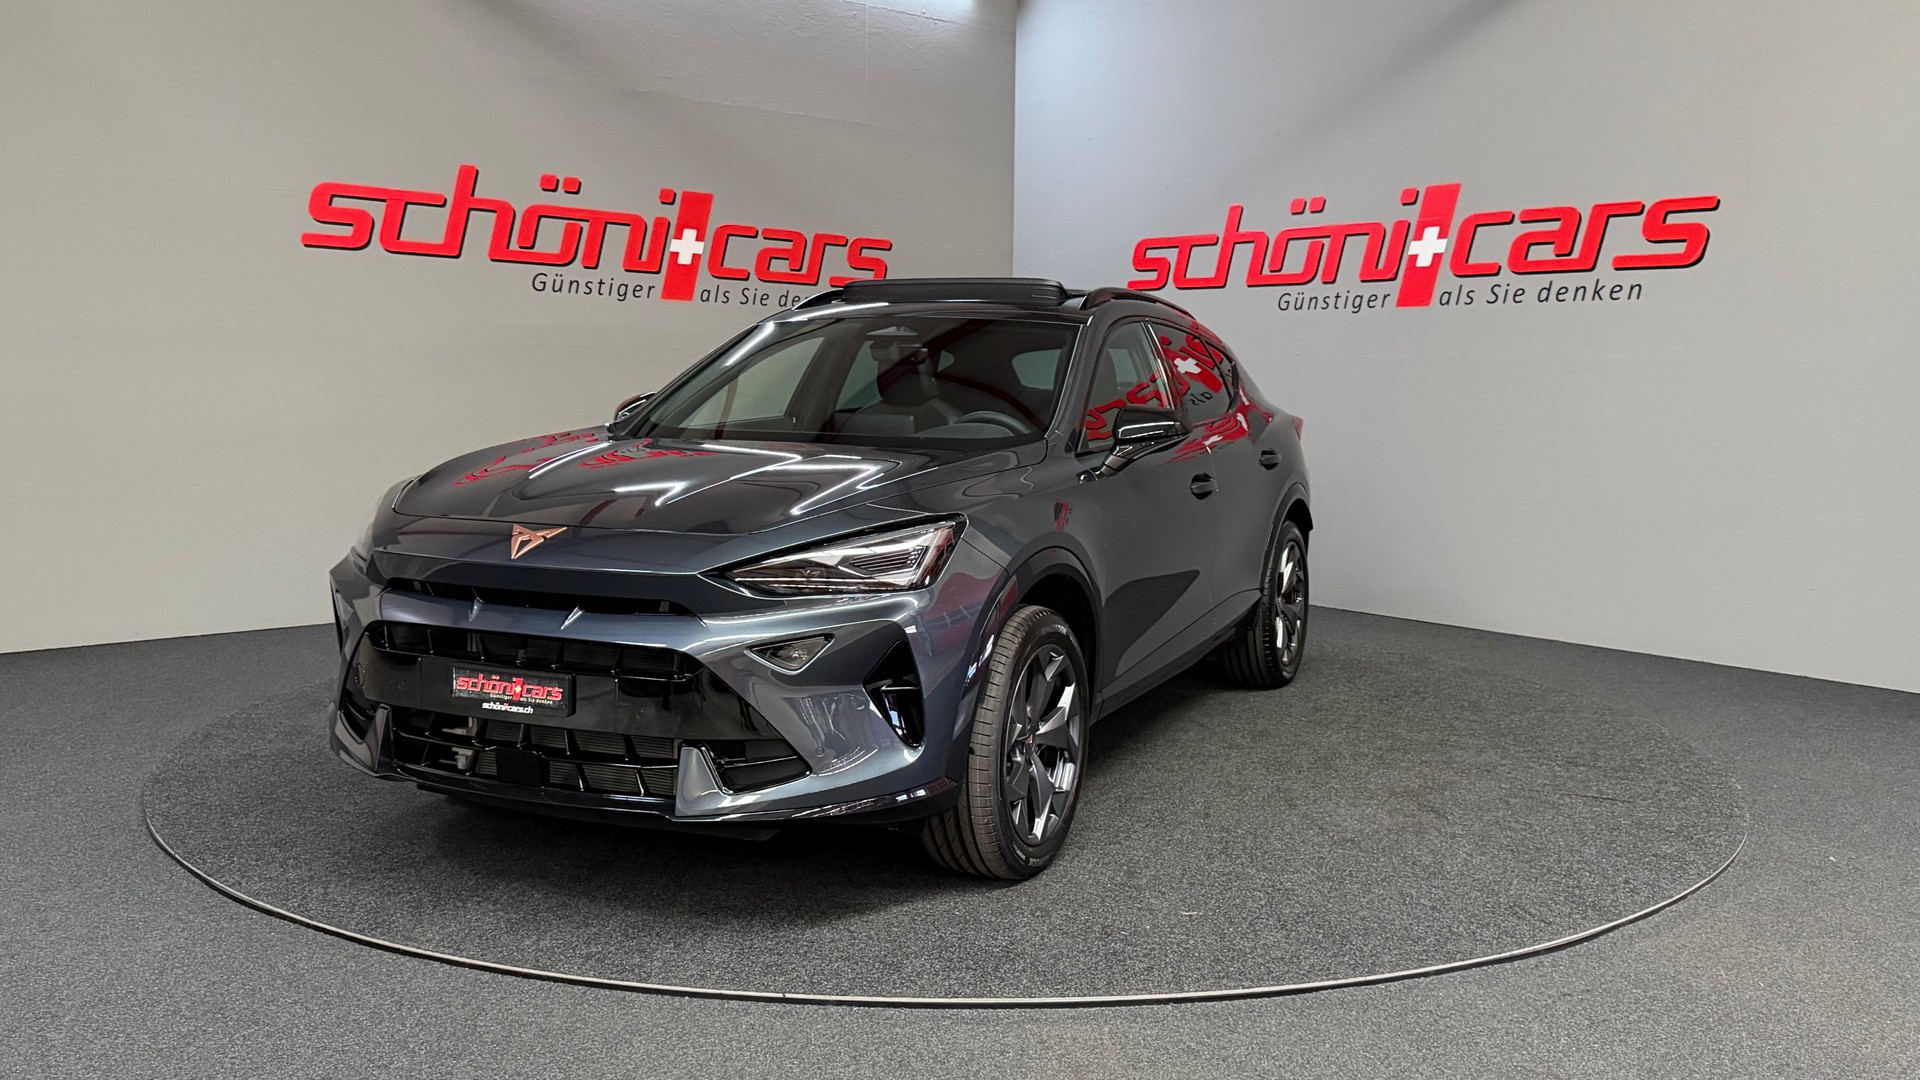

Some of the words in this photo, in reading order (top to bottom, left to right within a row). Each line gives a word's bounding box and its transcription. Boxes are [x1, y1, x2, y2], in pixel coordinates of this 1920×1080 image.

[708, 223, 892, 288] cars
[1449, 194, 1721, 278] cars
[531, 272, 656, 302] Günstiger
[700, 284, 731, 304] als
[739, 287, 770, 306] Sie
[1277, 290, 1391, 314] Günstiger
[1439, 284, 1476, 306] als
[1486, 283, 1526, 305] Sie
[1537, 278, 1643, 303] denken
